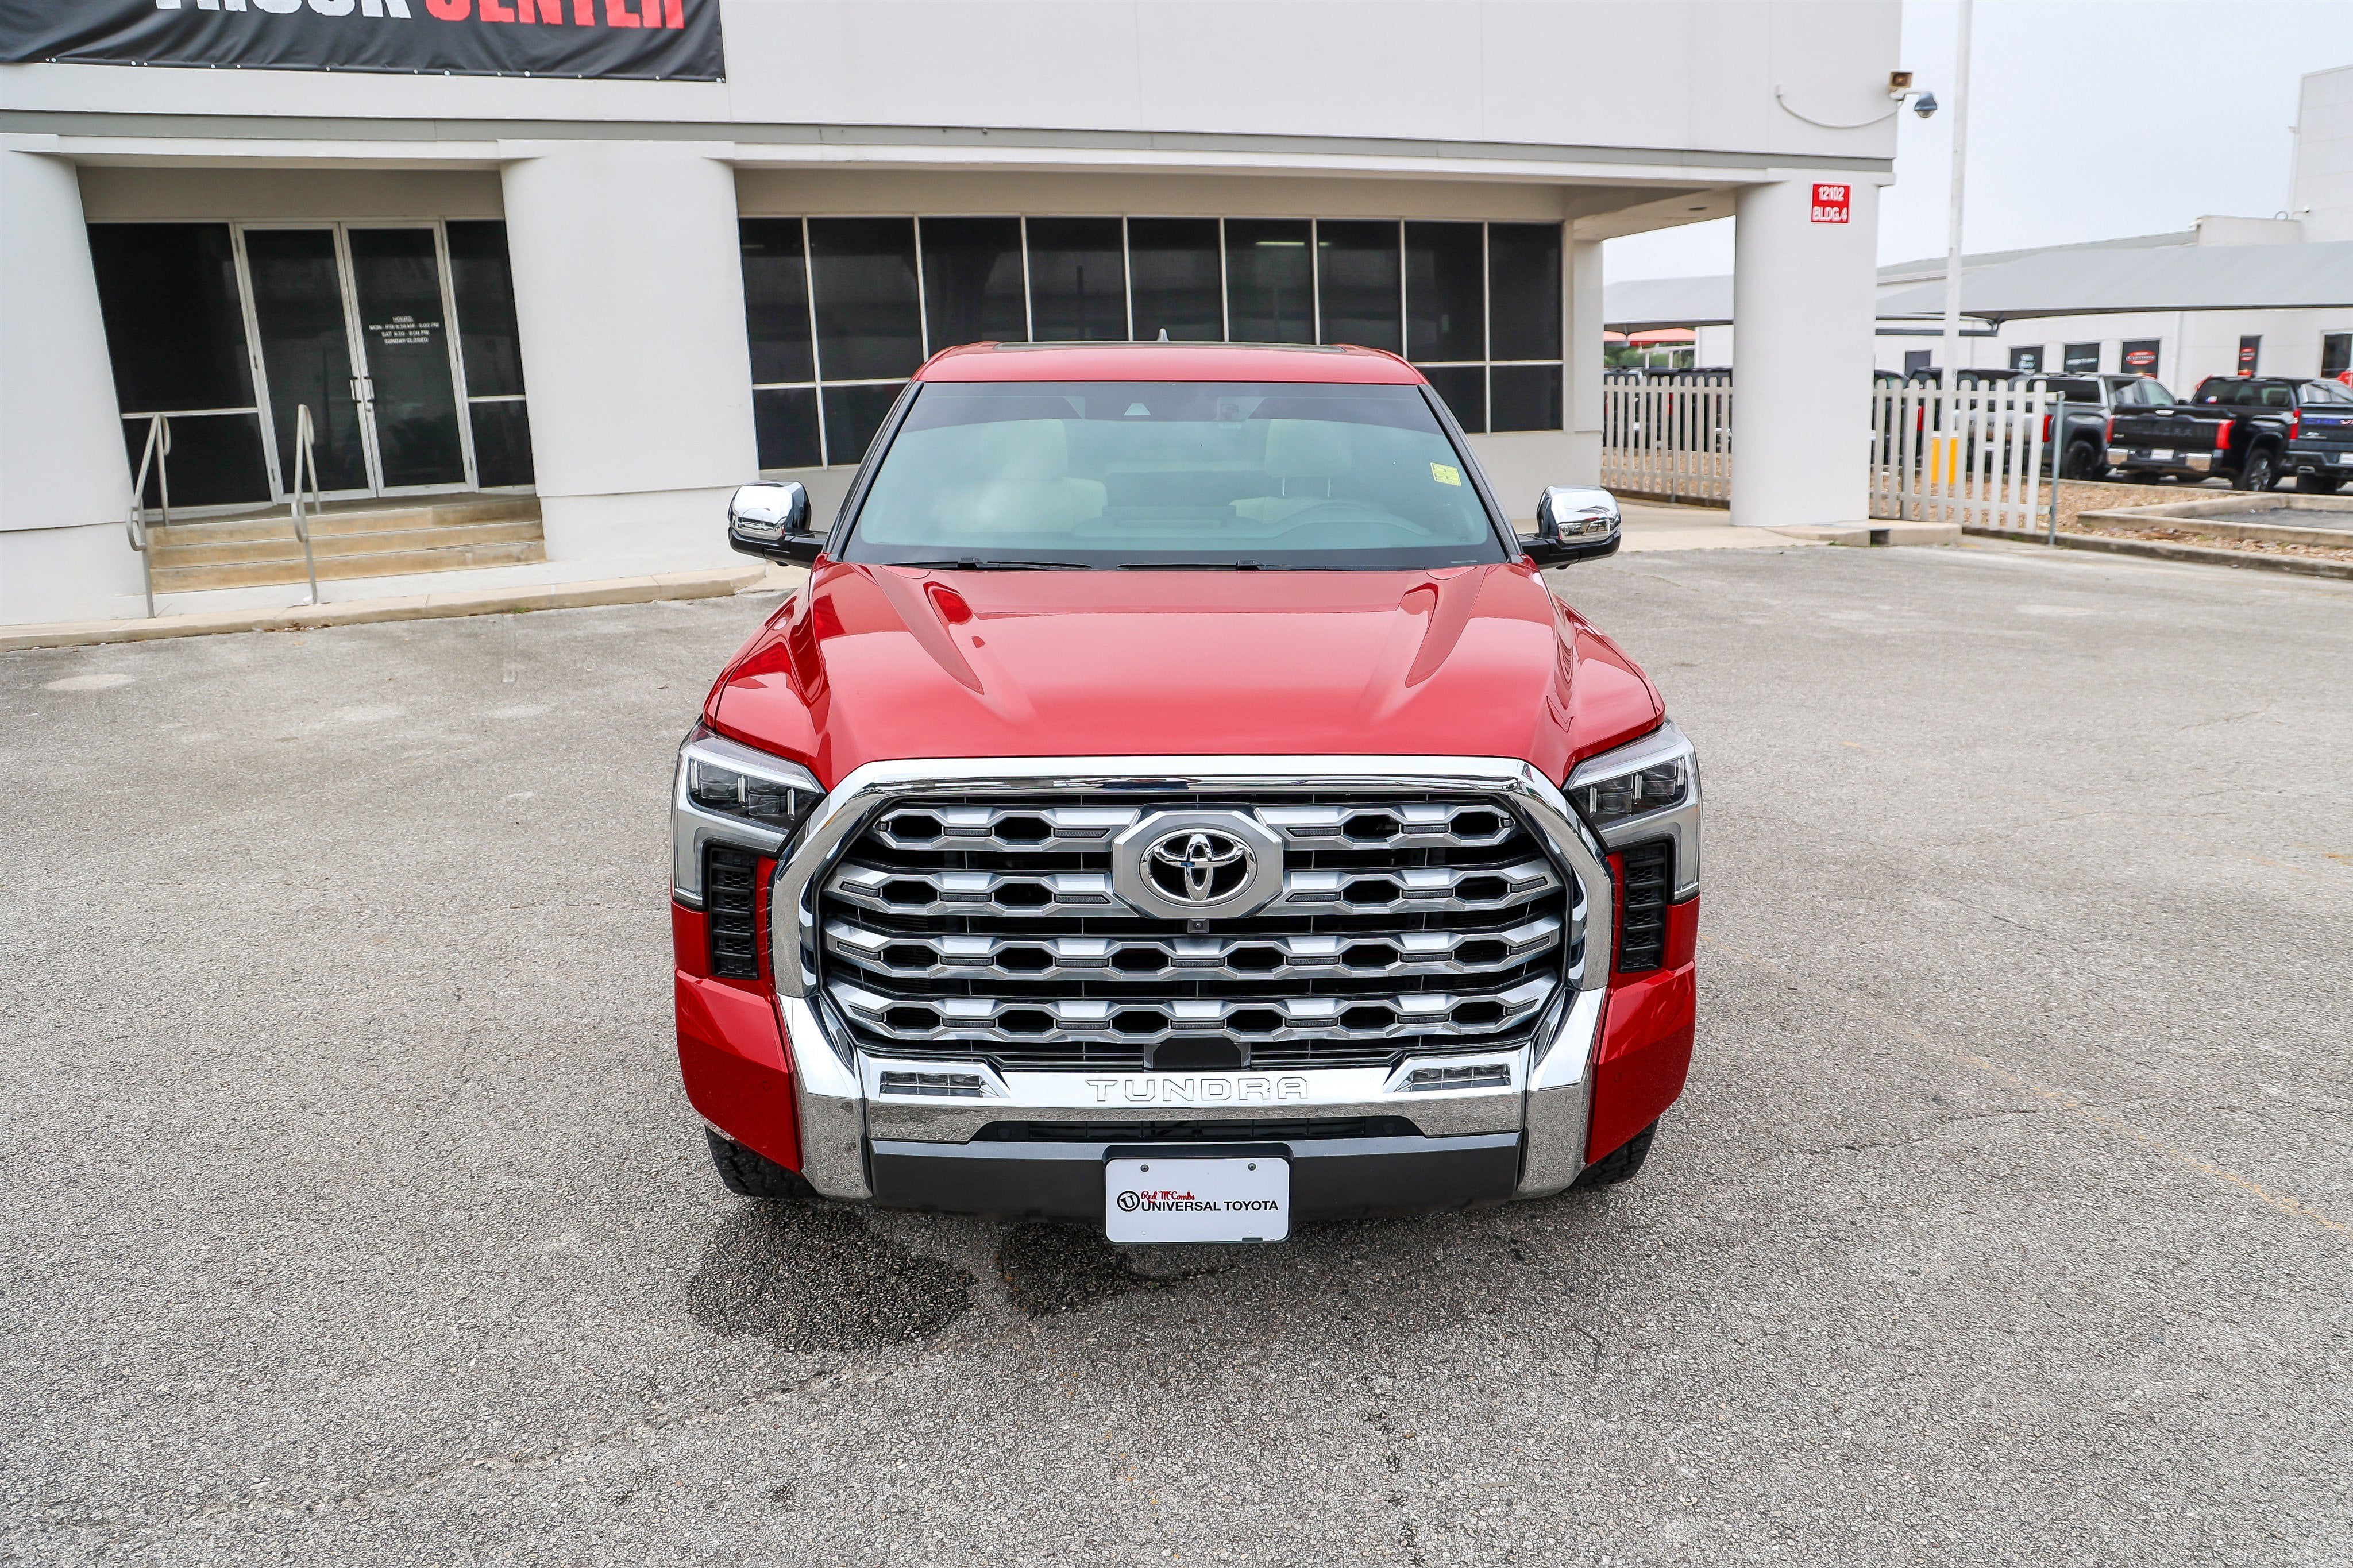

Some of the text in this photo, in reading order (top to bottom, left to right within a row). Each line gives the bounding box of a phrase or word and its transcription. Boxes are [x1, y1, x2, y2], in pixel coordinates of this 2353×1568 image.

[1818, 186, 1845, 202] 12102
[1085, 1077, 1309, 1102] TUNDRA
[1140, 1190, 1158, 1204] Red
[1141, 1200, 1279, 1211] UNIVERSAL TOYOTA
